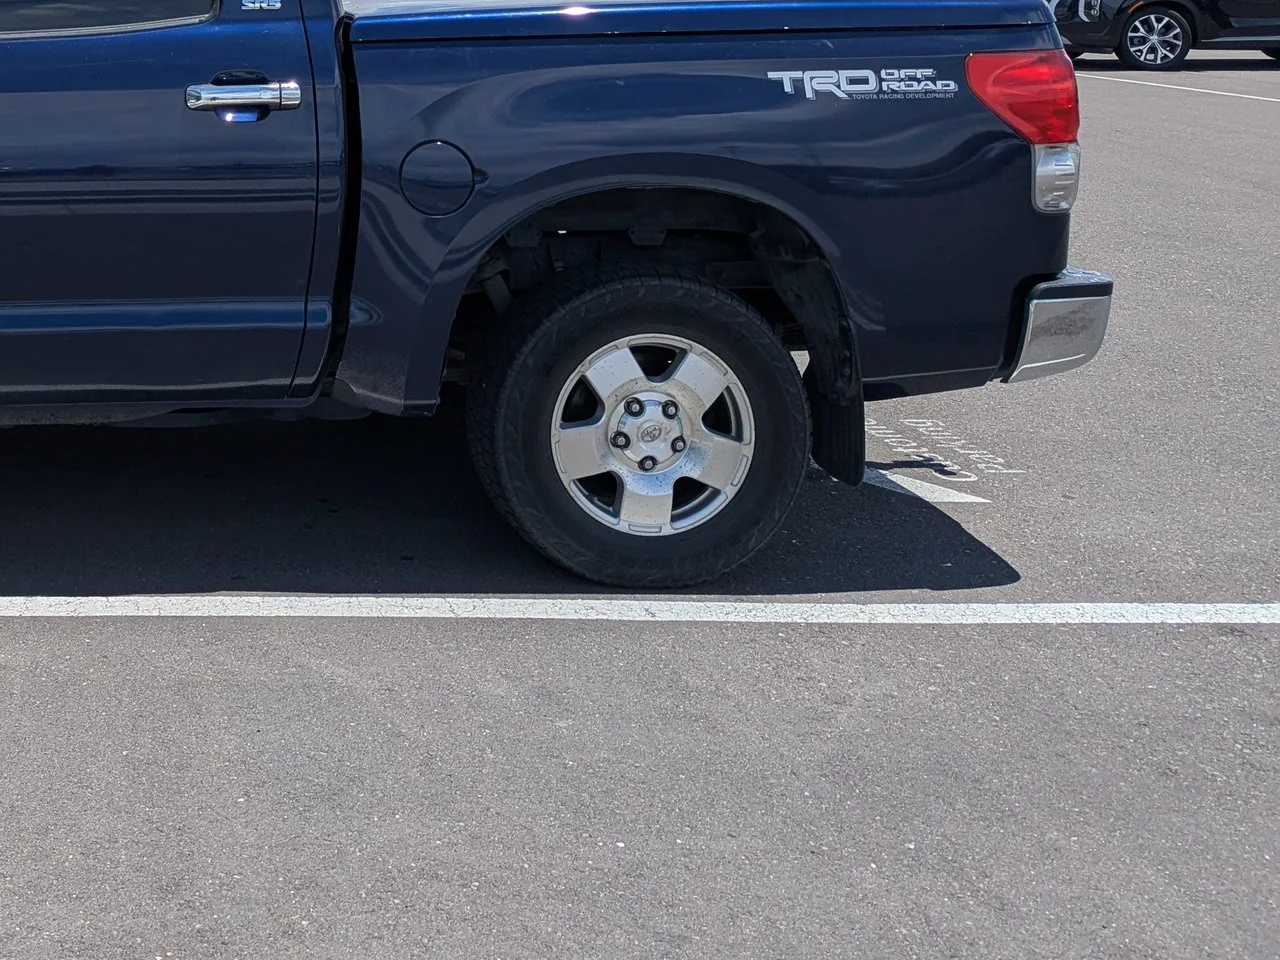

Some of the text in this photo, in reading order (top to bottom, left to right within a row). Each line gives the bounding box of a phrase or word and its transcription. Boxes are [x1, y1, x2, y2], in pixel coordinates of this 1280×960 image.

[880, 68, 936, 81] OFF
[767, 69, 880, 100] TRD
[881, 80, 959, 92] ROAD
